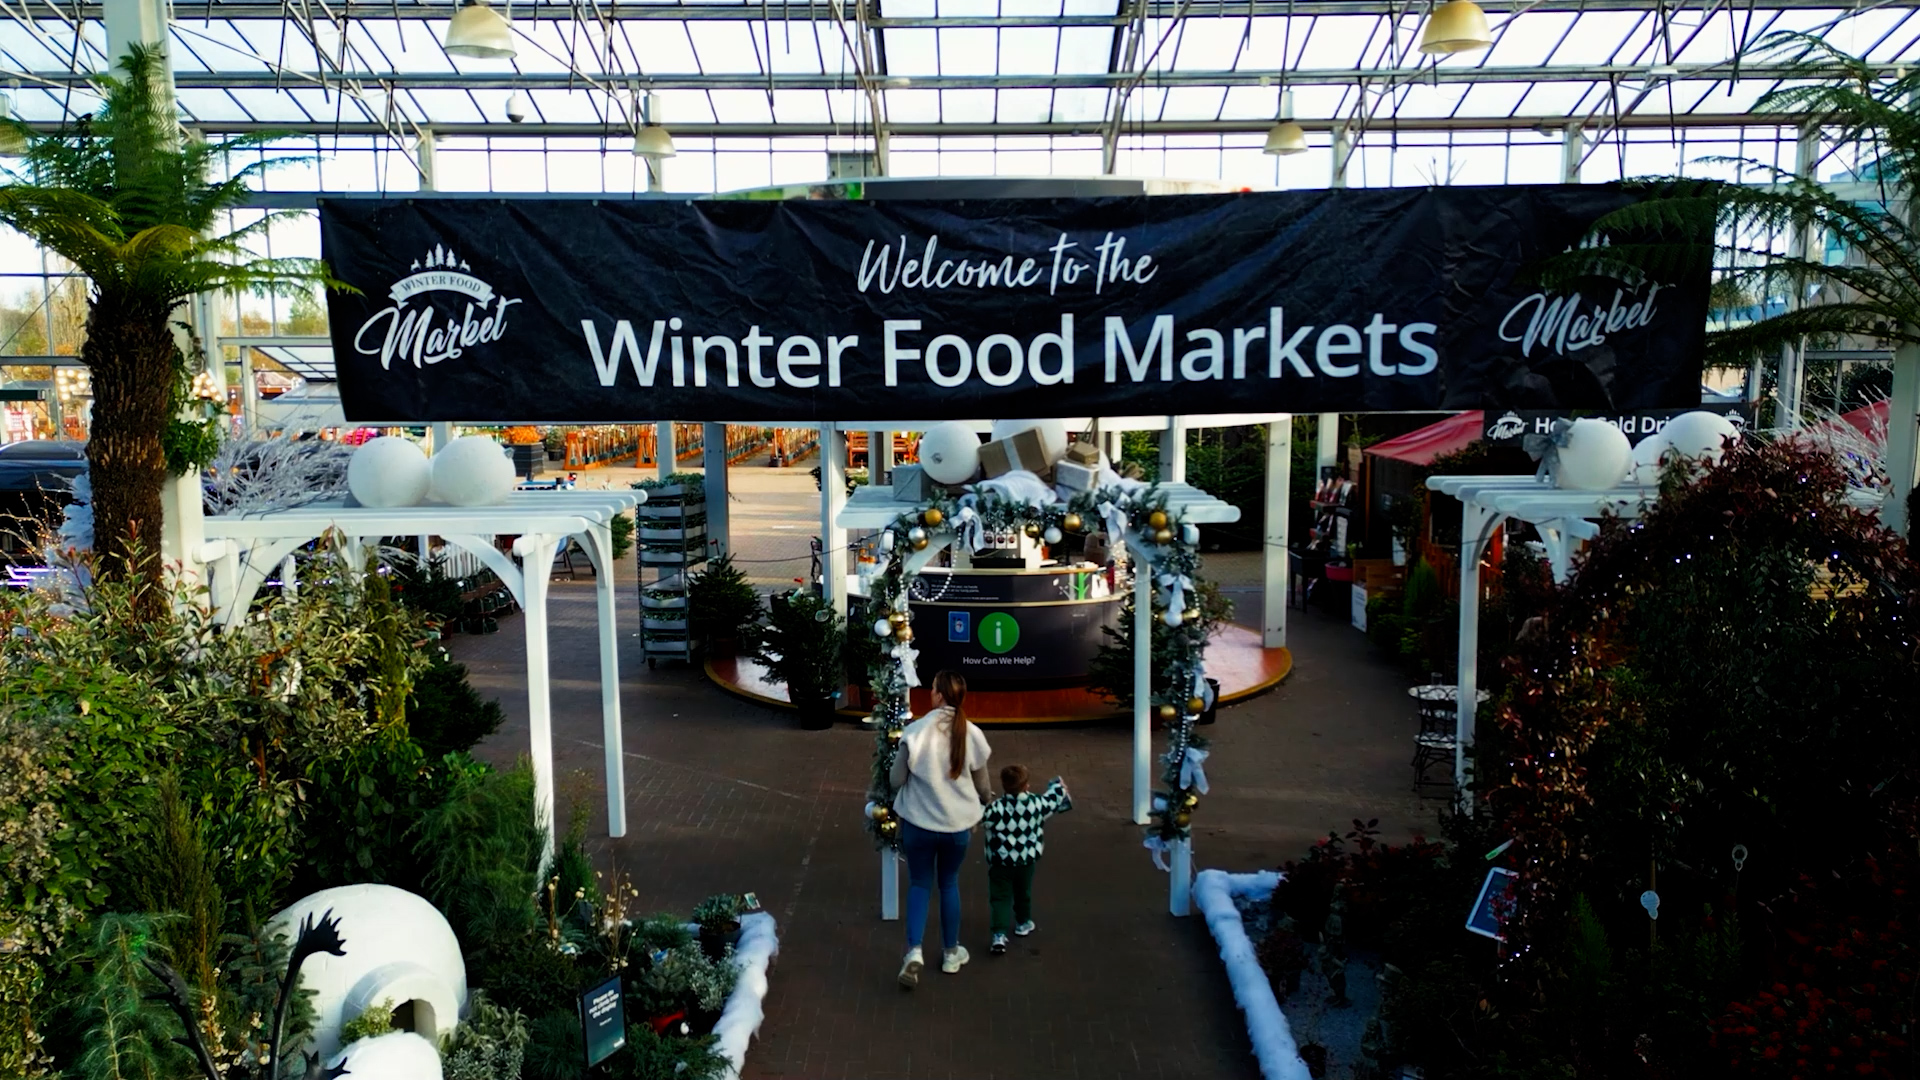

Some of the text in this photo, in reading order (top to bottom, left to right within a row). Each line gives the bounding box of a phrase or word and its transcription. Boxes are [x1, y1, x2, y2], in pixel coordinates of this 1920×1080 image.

[400, 274, 482, 293] WINTER FOOD
[857, 231, 1158, 296] Welcome to the
[354, 294, 523, 371] Market
[580, 306, 1438, 388] Winter Food Markets
[1498, 280, 1677, 358] Market
[962, 656, 1036, 666] How Can We Help?
